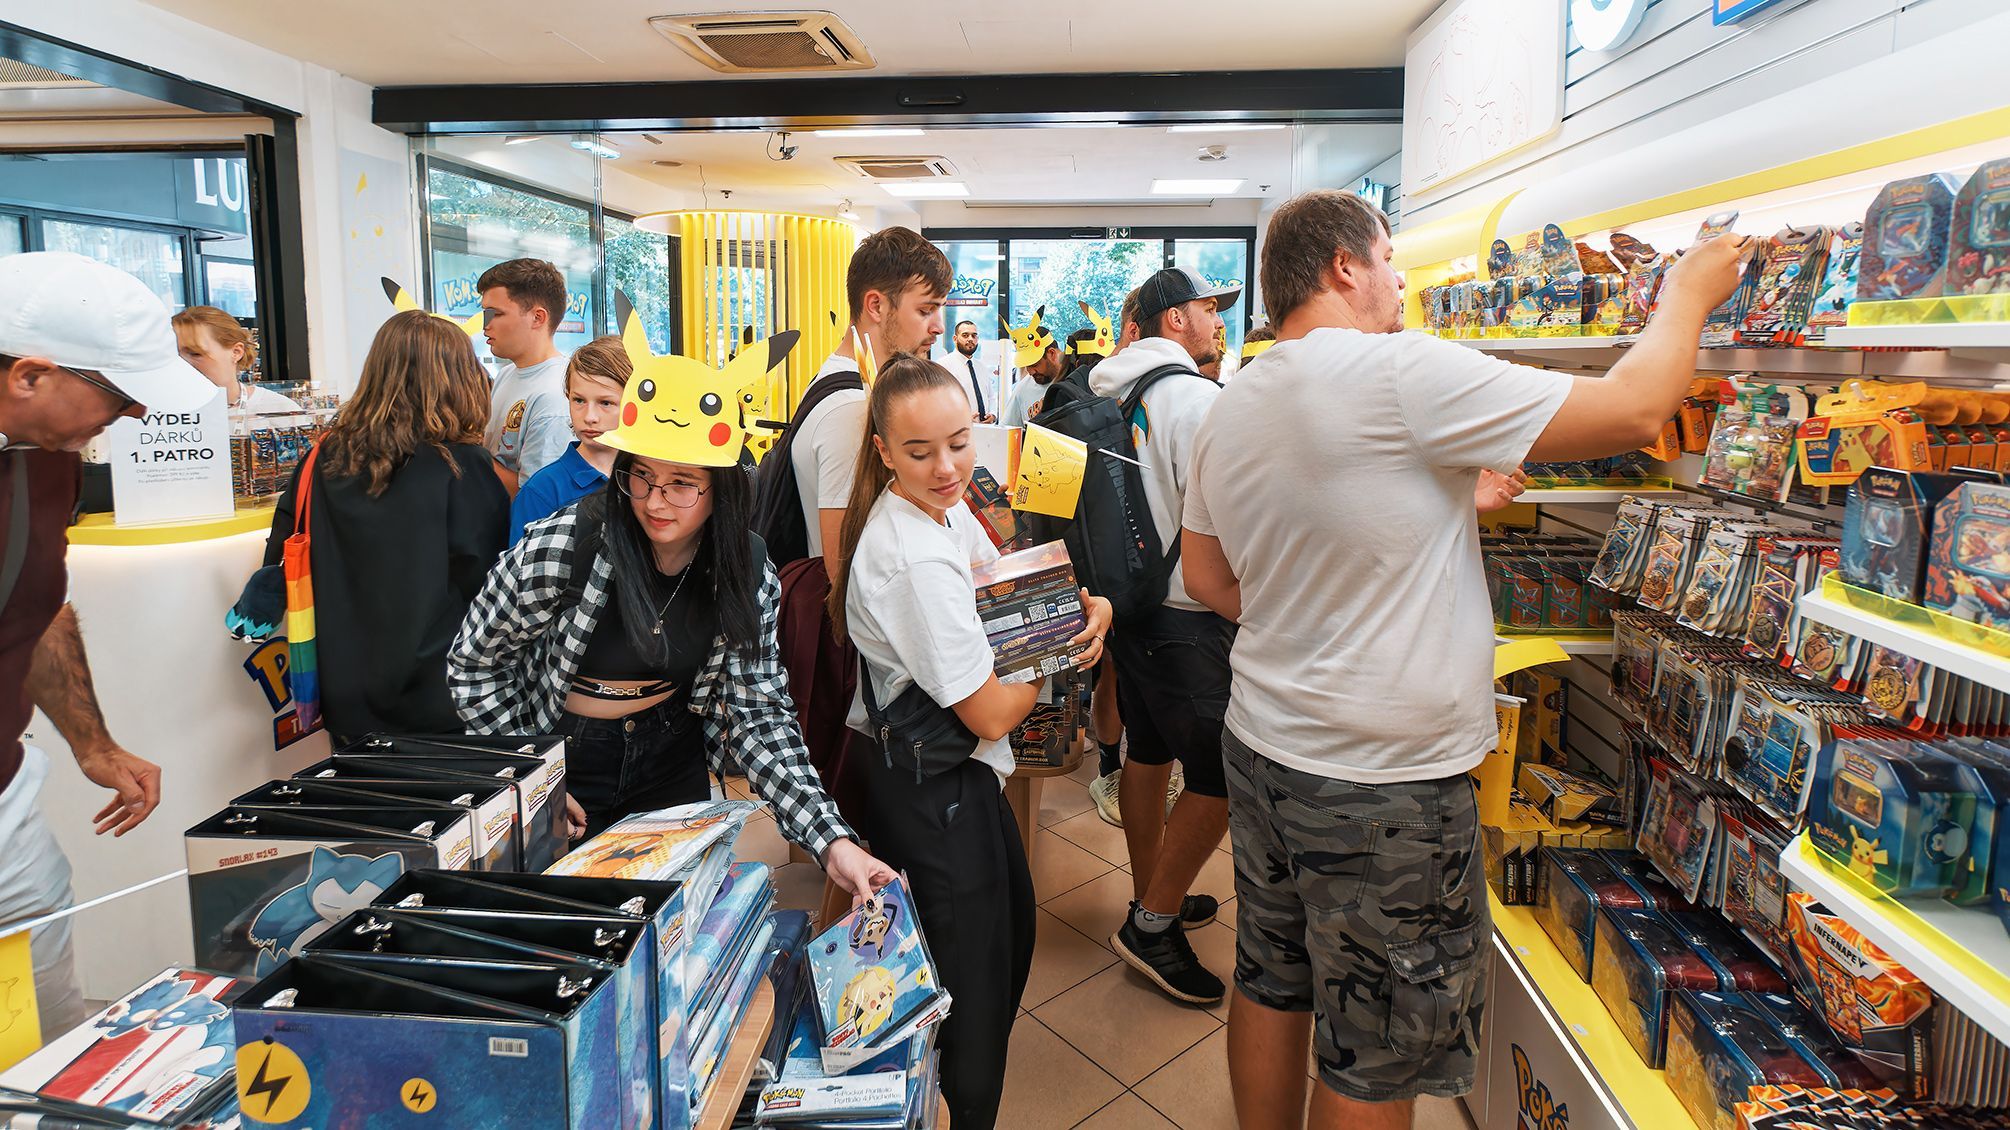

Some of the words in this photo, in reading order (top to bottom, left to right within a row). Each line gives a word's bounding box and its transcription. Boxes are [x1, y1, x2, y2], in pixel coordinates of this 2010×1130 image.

[140, 428, 203, 445] DÁRKŮ
[130, 452, 147, 463] 1.
[154, 448, 214, 462] PATRO
[219, 852, 254, 867] SNORLAX
[1813, 922, 1857, 965] INFERNAPE
